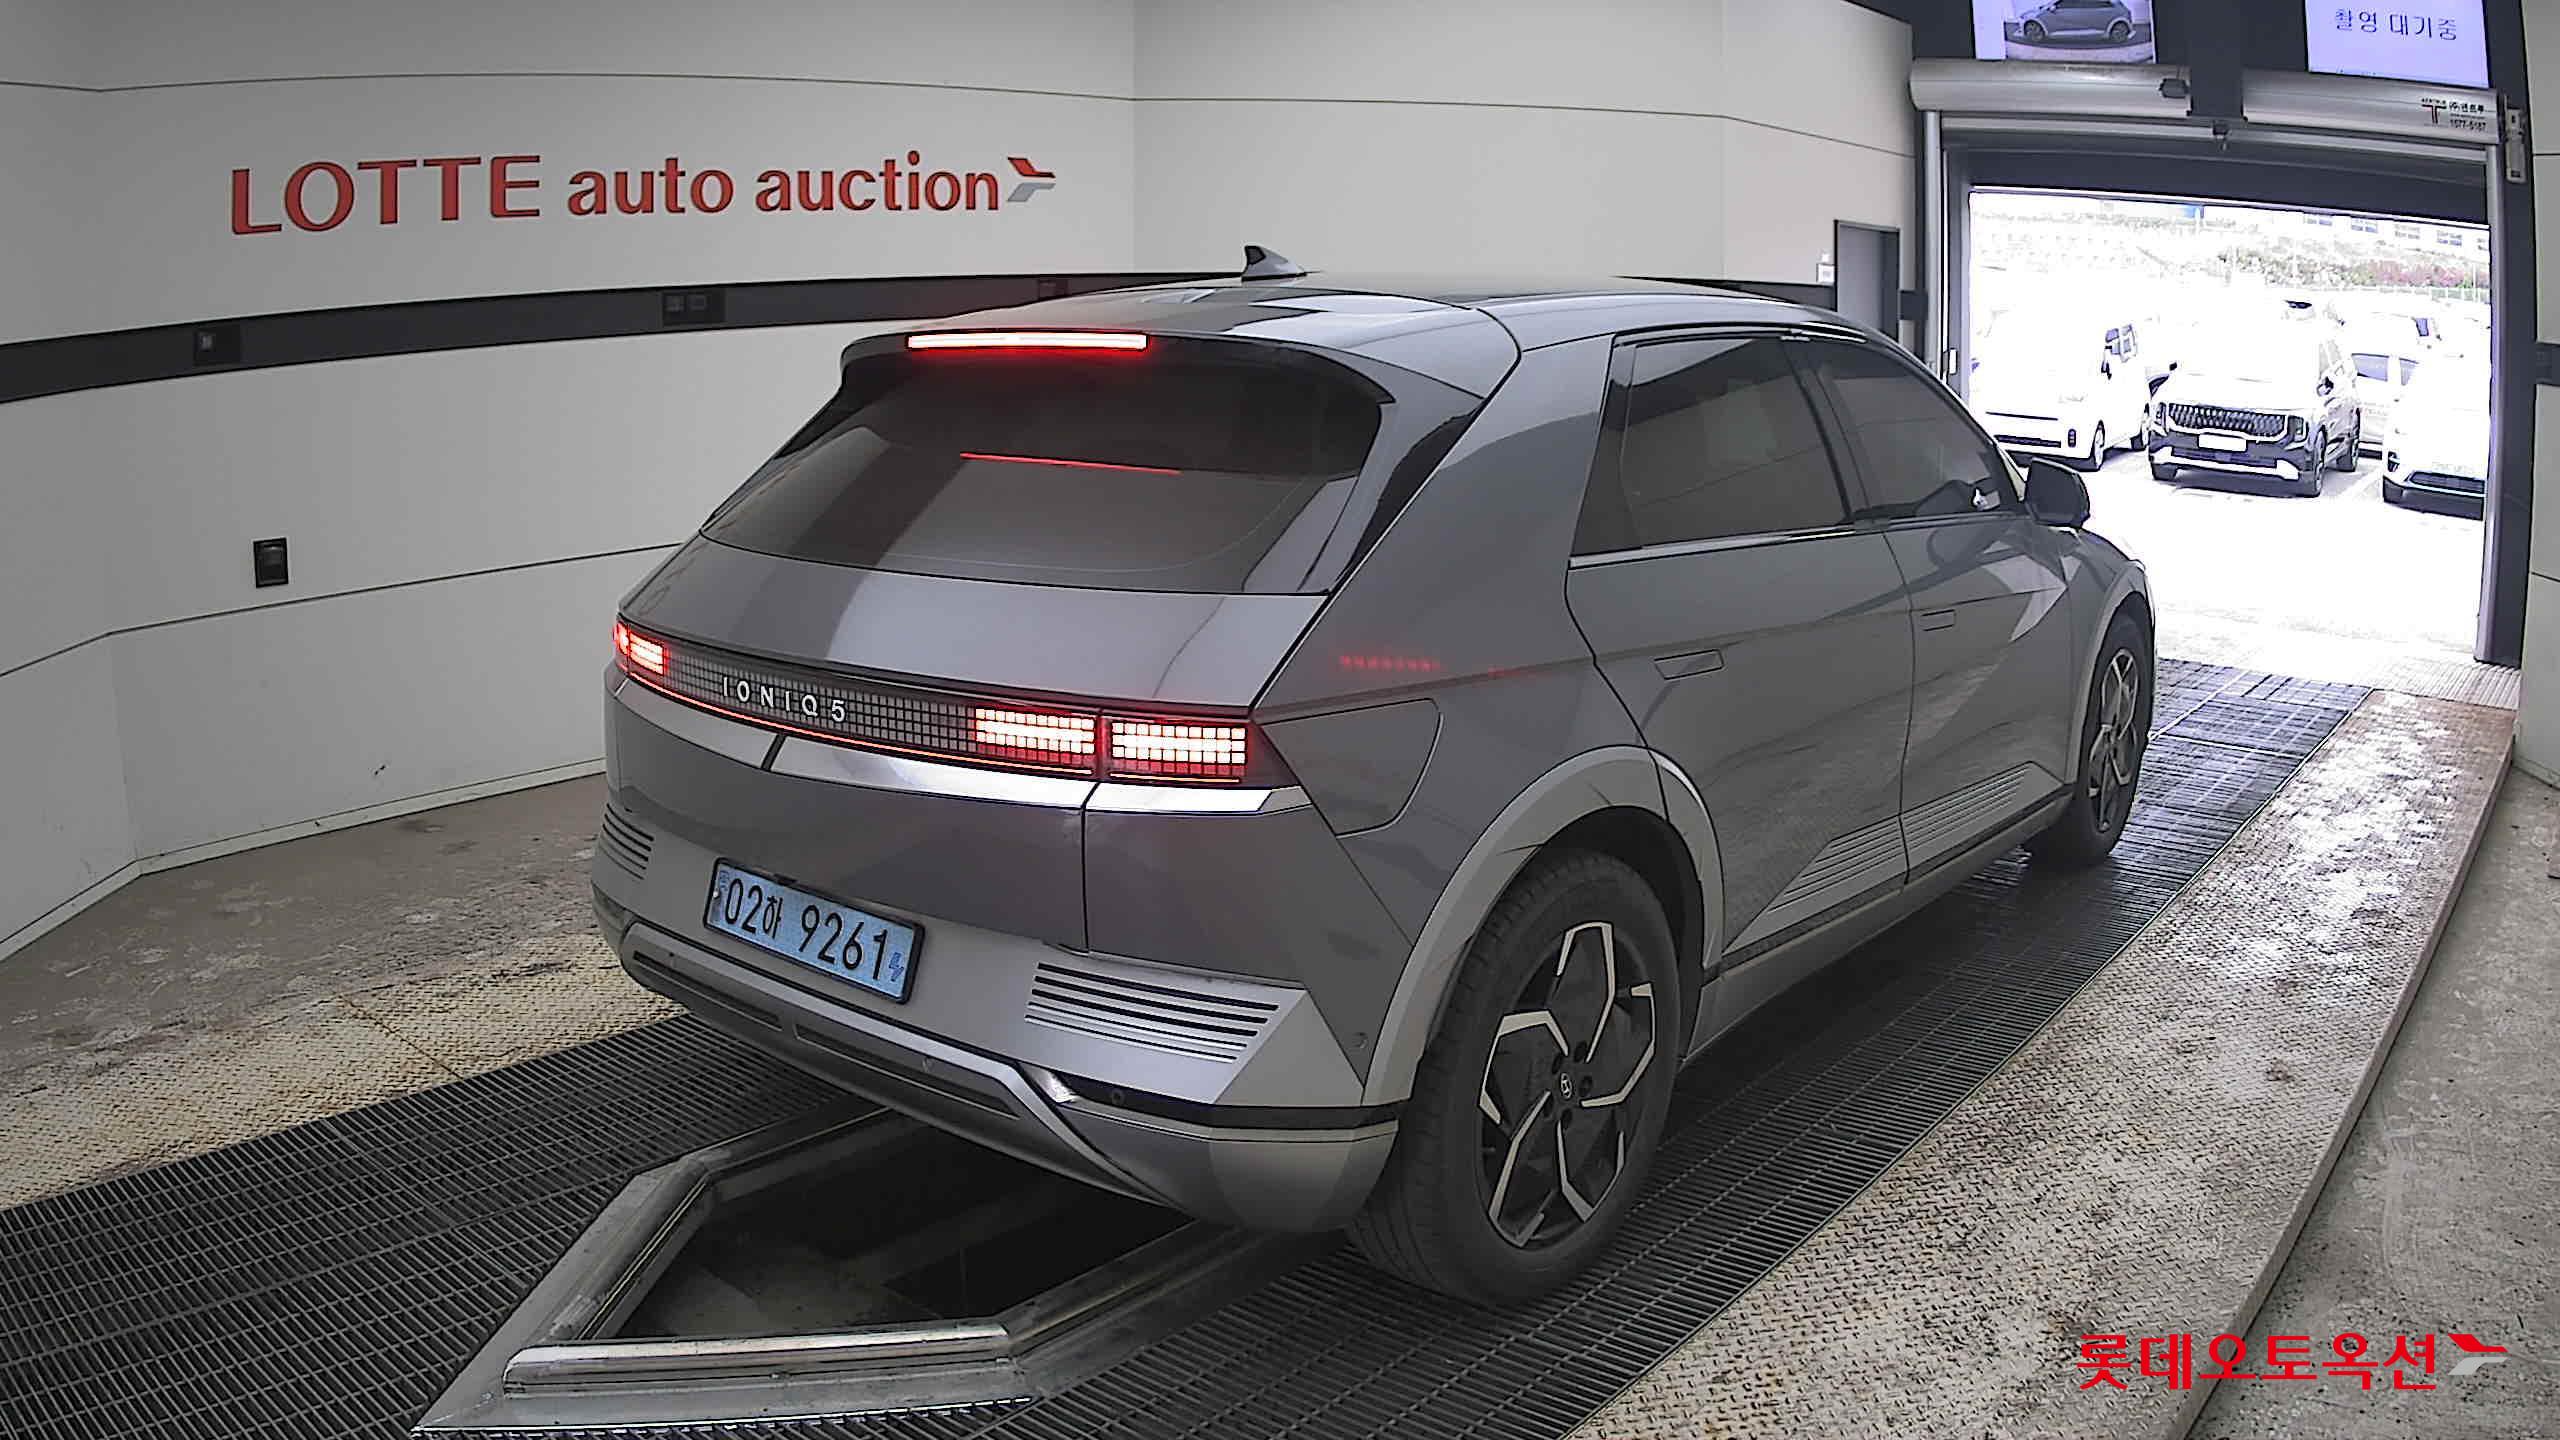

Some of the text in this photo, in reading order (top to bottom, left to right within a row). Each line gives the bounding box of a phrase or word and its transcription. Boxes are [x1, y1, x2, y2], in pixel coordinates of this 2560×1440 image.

[2335, 8, 2457, 40] 촬영 대기중
[230, 149, 1000, 236] LOTTE auto auction
[722, 676, 846, 722] IONIQ 5
[724, 877, 784, 940] 02하
[798, 904, 889, 982] 9261
